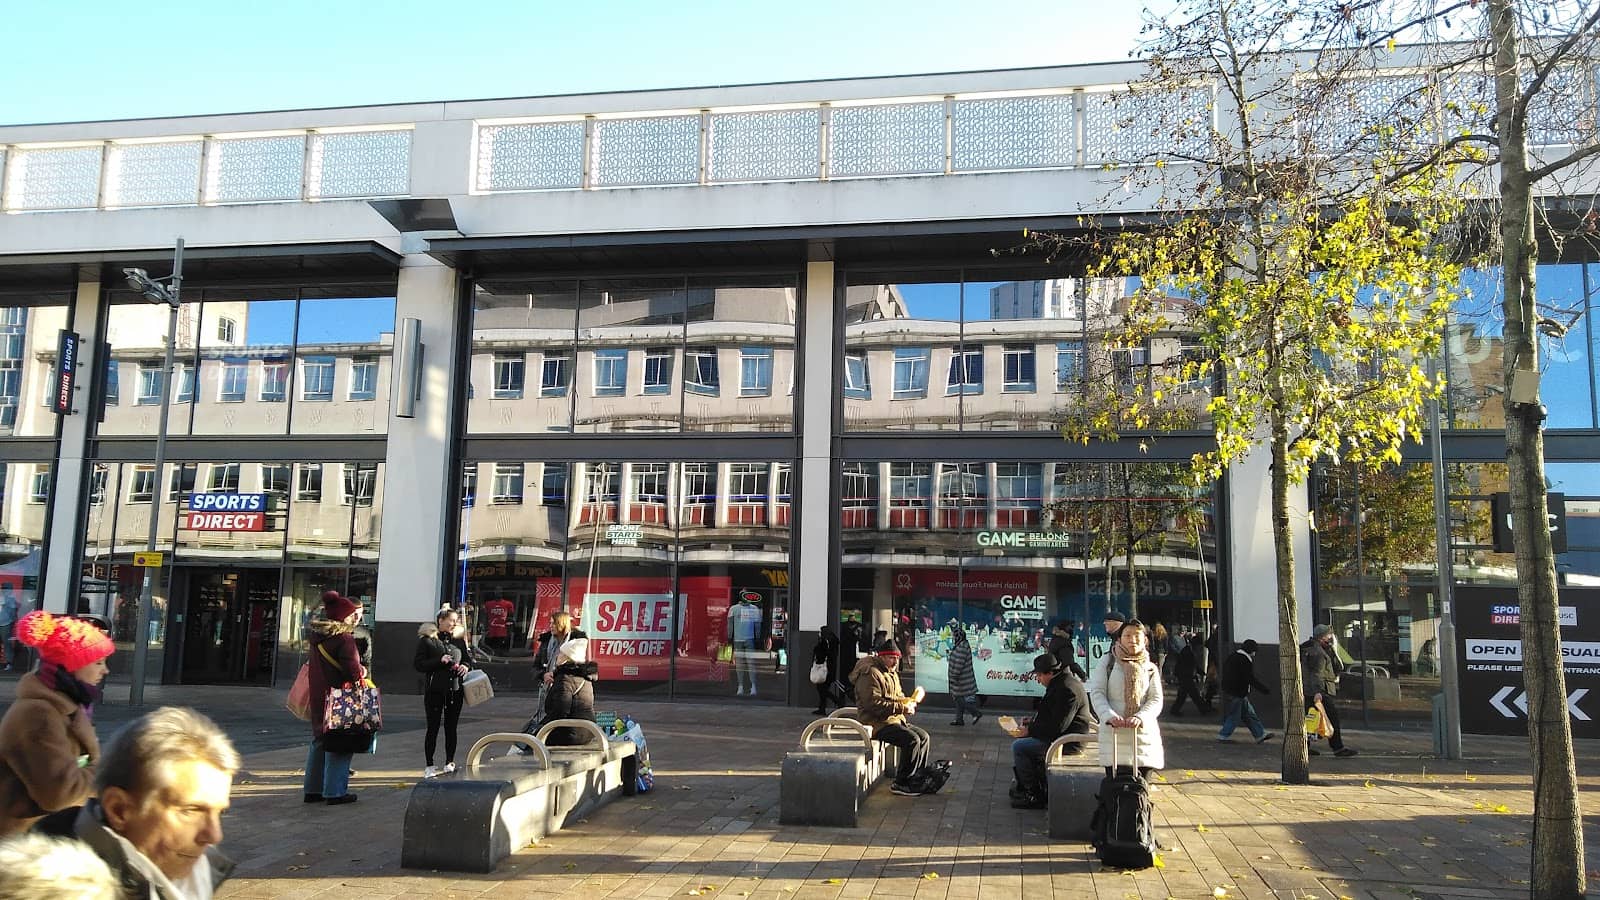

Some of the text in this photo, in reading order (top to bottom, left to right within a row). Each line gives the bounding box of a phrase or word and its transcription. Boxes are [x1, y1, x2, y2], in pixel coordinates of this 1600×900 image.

[59, 337, 74, 408] SPORTS DIRECT
[193, 494, 260, 510] SPORTS
[191, 514, 258, 529] DIRECT
[976, 531, 1026, 547] GAME
[1029, 532, 1069, 541] BELONG
[1000, 594, 1047, 610] GAME
[1493, 606, 1520, 614] SPOR
[596, 600, 670, 632] SALE
[1494, 615, 1520, 623] DIRE
[606, 640, 635, 656] 70%
[638, 640, 665, 656] OFF
[1471, 645, 1600, 657] OPEN SUAL
